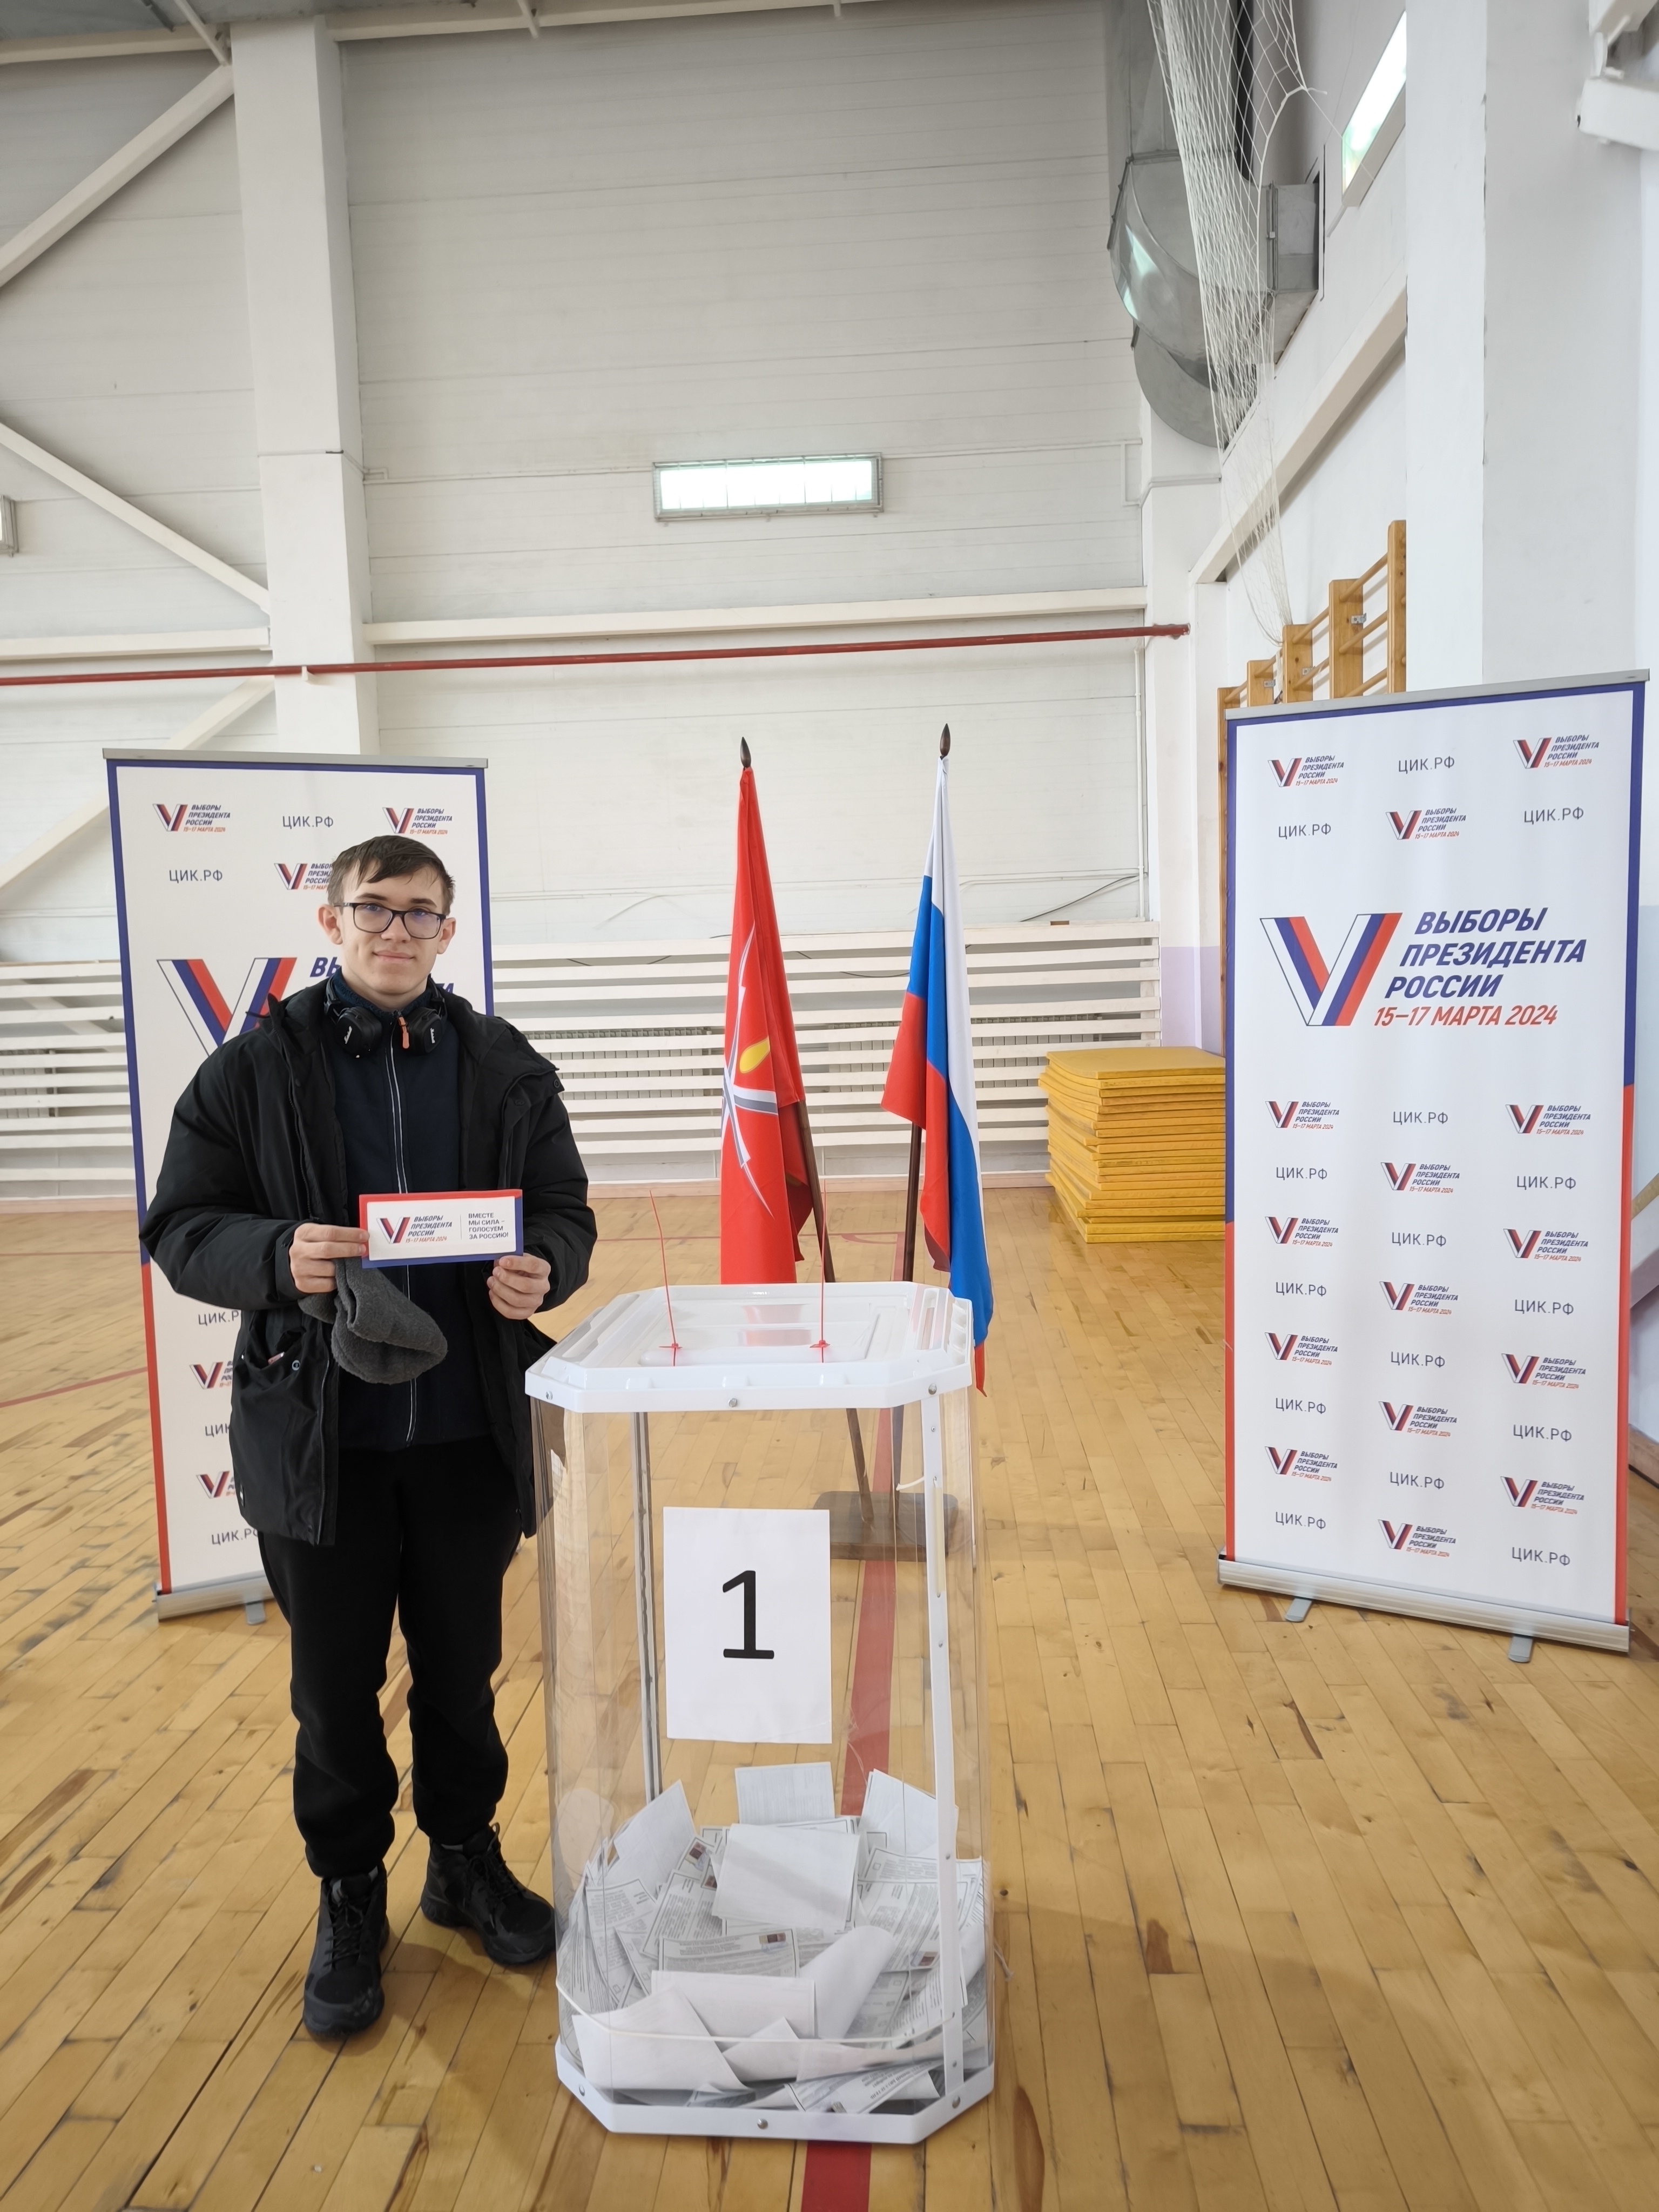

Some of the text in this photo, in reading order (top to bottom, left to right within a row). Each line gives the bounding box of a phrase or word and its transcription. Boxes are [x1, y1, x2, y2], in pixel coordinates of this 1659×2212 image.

[1555, 734, 1589, 743] ВЫБОРЫ
[1551, 741, 1599, 751] ПРЕЗИДЕНТА
[1547, 752, 1578, 760] РОССИИ
[1301, 762, 1344, 771] ПРЕЗИДЕНТА
[1399, 756, 1454, 774] ЦИК.РФ
[1421, 814, 1466, 823] ПРЕЗИДЕНТА
[1524, 807, 1583, 825] ЦИК.РФ
[282, 816, 333, 830] ЦИК.РФ
[1279, 823, 1331, 839] ЦИК.РФ
[169, 869, 222, 884] ЦИК.РФ
[1414, 907, 1548, 935] ВЫБОРЫ
[1400, 939, 1587, 969] ПРЕЗИДЕНТА
[1385, 974, 1503, 999] РОССИИ
[1432, 1005, 1501, 1025] МАРТА
[1505, 1005, 1557, 1025] 2024
[1393, 1111, 1448, 1125] ЦИК.РФ
[1276, 1167, 1327, 1181] ЦИК.РФ
[1517, 1176, 1576, 1190] ЦИК.РФ
[410, 1222, 453, 1230] ПРЕЗИДЕНТА
[1392, 1232, 1446, 1247] ЦИК.РФ
[1276, 1282, 1326, 1297] ЦИК.РФ
[1414, 1292, 1458, 1300] ПРЕЗИДЕНТА
[1515, 1299, 1574, 1315] ЦИК.РФ
[1297, 1343, 1338, 1352] ПРЕЗИДЕНТА
[1391, 1352, 1445, 1368] ЦИК.РФ
[1543, 1357, 1576, 1366] ВЫБОРЫ
[1539, 1365, 1586, 1374] ПРЕЗИДЕНТА
[1535, 1372, 1565, 1380] РОССИИ
[1276, 1398, 1326, 1414] ЦИК.РФ
[1417, 1406, 1447, 1414] ВЫБОРЫ
[1413, 1413, 1456, 1424] ПРЕЗИДЕНТА
[1410, 1420, 1438, 1429] РОССИИ
[1513, 1425, 1572, 1441] ЦИК.РФ
[1300, 1451, 1329, 1460] ВЫБОРЫ
[1297, 1458, 1337, 1468] ПРЕЗИДЕНТА
[1294, 1465, 1320, 1473] РОССИИ
[1390, 1472, 1444, 1489] ЦИК.РФ
[1541, 1481, 1574, 1491] ВЫБОРЫ
[1537, 1489, 1584, 1500] ПРЕЗИДЕНТА
[1534, 1496, 1564, 1506] РОССИИ
[1276, 1512, 1326, 1529] ЦИК.РФ
[1416, 1526, 1447, 1535] ВЫБОРЫ
[1413, 1533, 1456, 1544] ПРЕЗИДЕНТА
[1409, 1540, 1437, 1549] РОССИИ
[1512, 1547, 1570, 1566] ЦИК.РФ
[723, 1570, 774, 1659] 1
